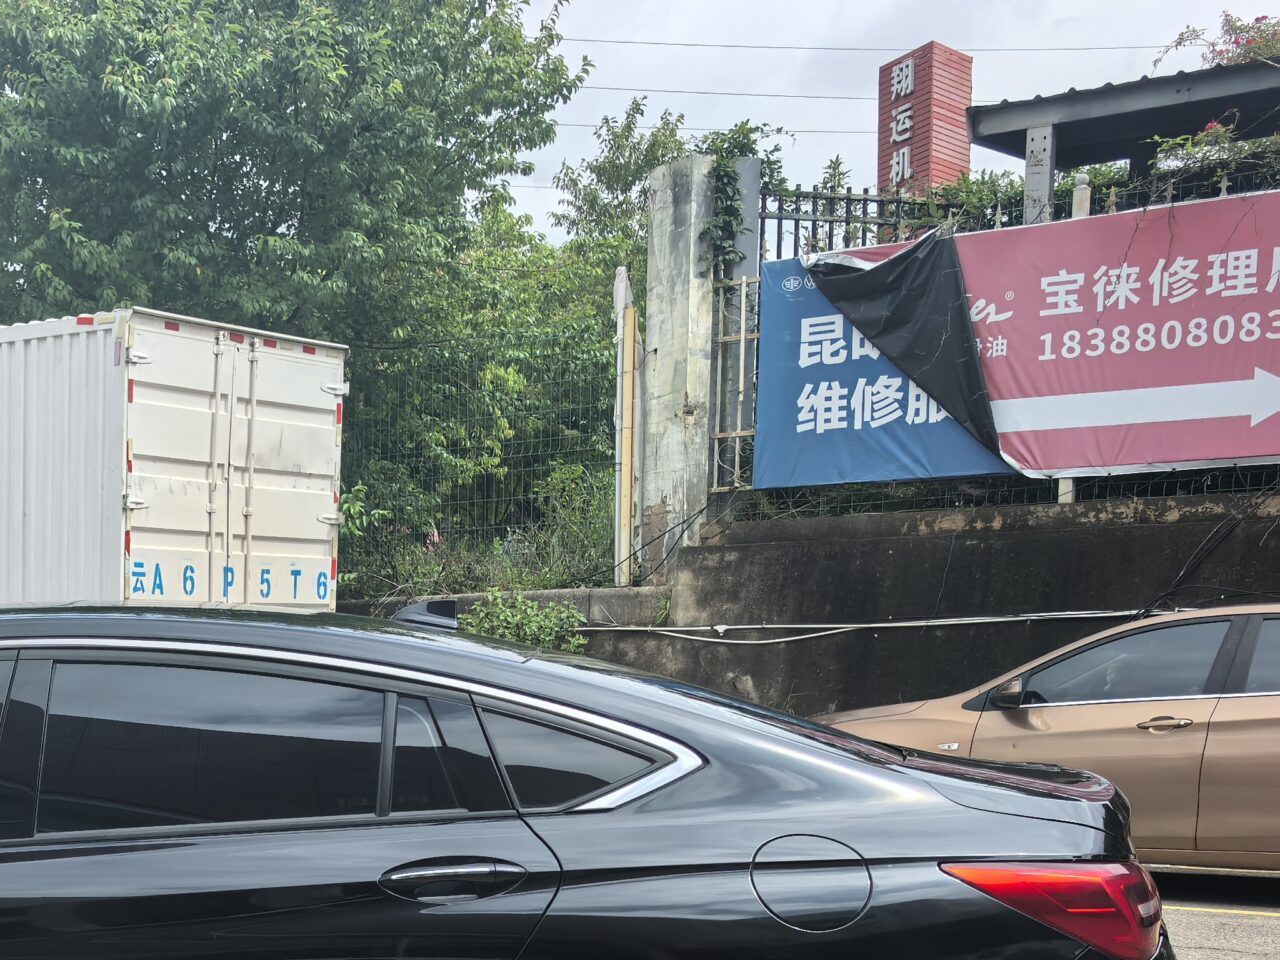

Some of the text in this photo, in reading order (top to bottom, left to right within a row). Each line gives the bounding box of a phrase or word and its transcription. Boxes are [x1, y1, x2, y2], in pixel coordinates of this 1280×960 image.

[889, 57, 915, 192] 翔运机
[1039, 247, 1280, 317] 宝徕修理
[976, 335, 1008, 358] 油
[1038, 309, 1280, 361] 1838808083
